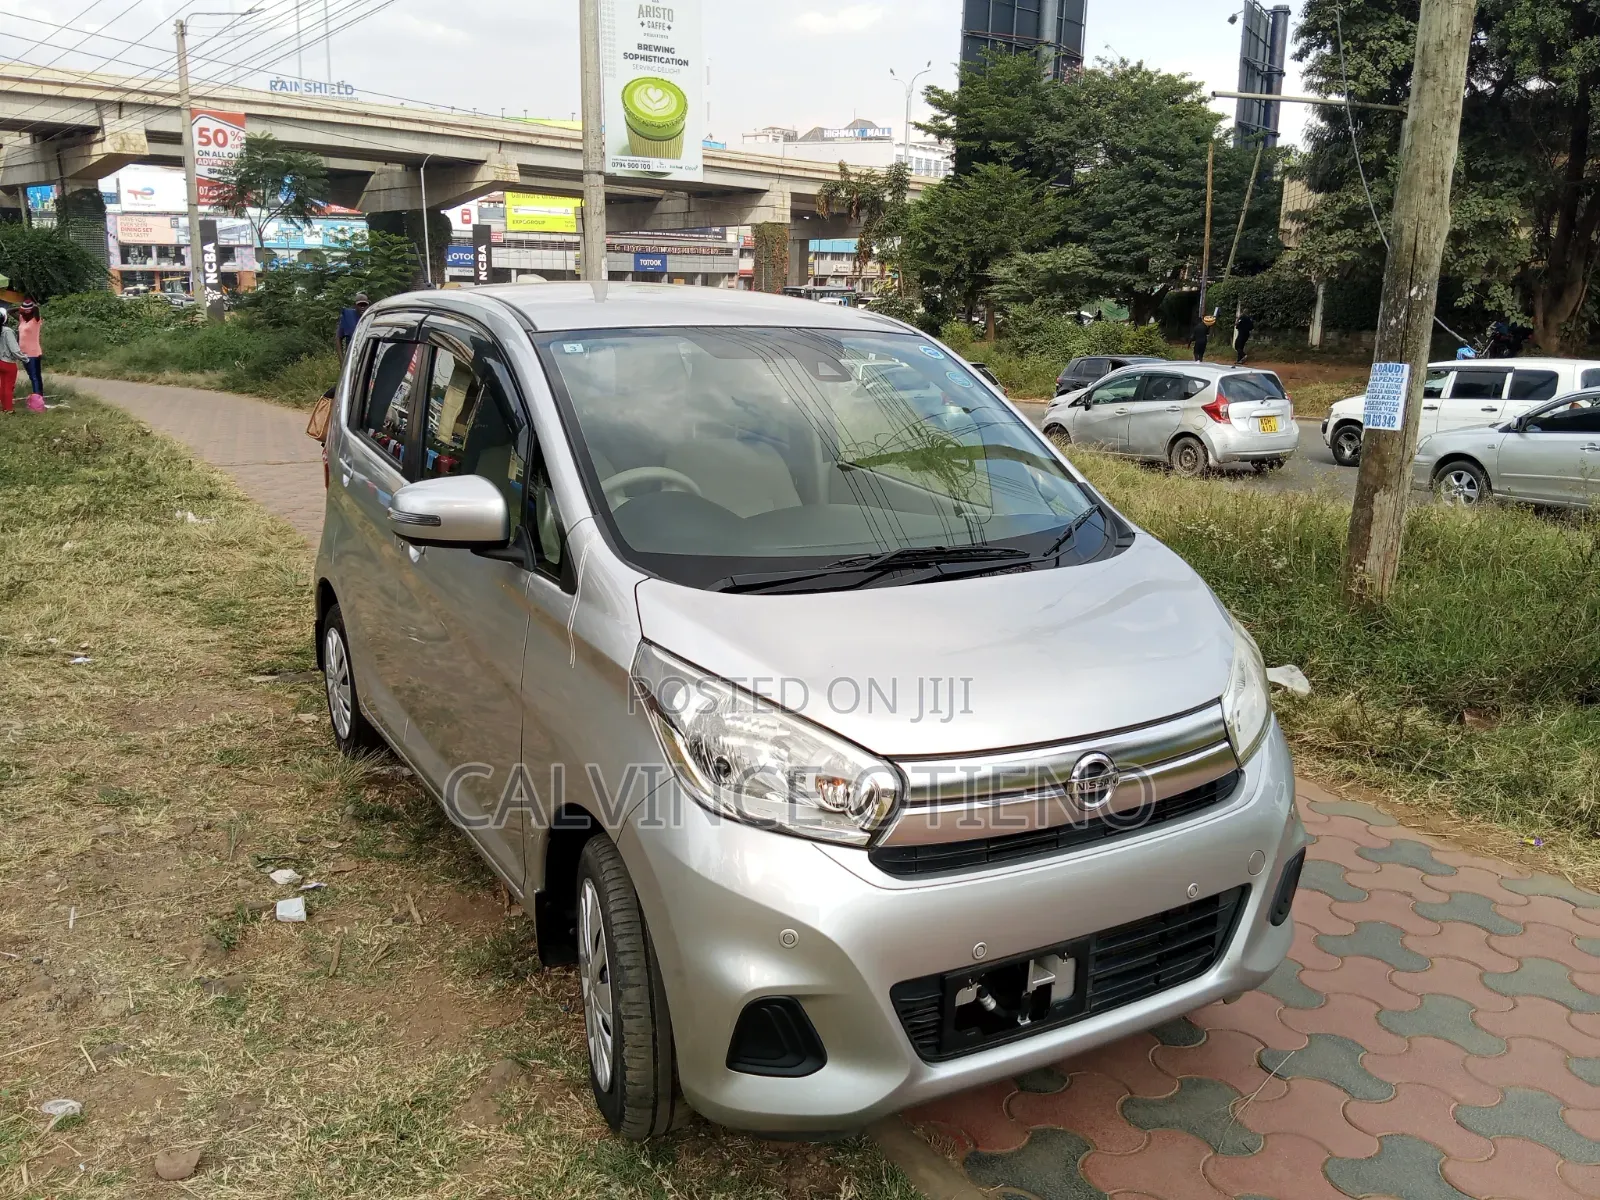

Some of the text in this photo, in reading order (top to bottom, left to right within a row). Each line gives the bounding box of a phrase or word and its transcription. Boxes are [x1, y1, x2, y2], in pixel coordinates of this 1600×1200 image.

[638, 4, 674, 22] ARISTO
[637, 43, 675, 54] BREWING
[623, 52, 689, 66] SOPHISTICATION
[632, 64, 656, 72] SERVING
[866, 129, 890, 137] MALL
[203, 242, 218, 284] NCBA
[478, 245, 488, 281] NCBA
[640, 258, 662, 268] TOTOOK
[1077, 774, 1119, 791] NISSAN
